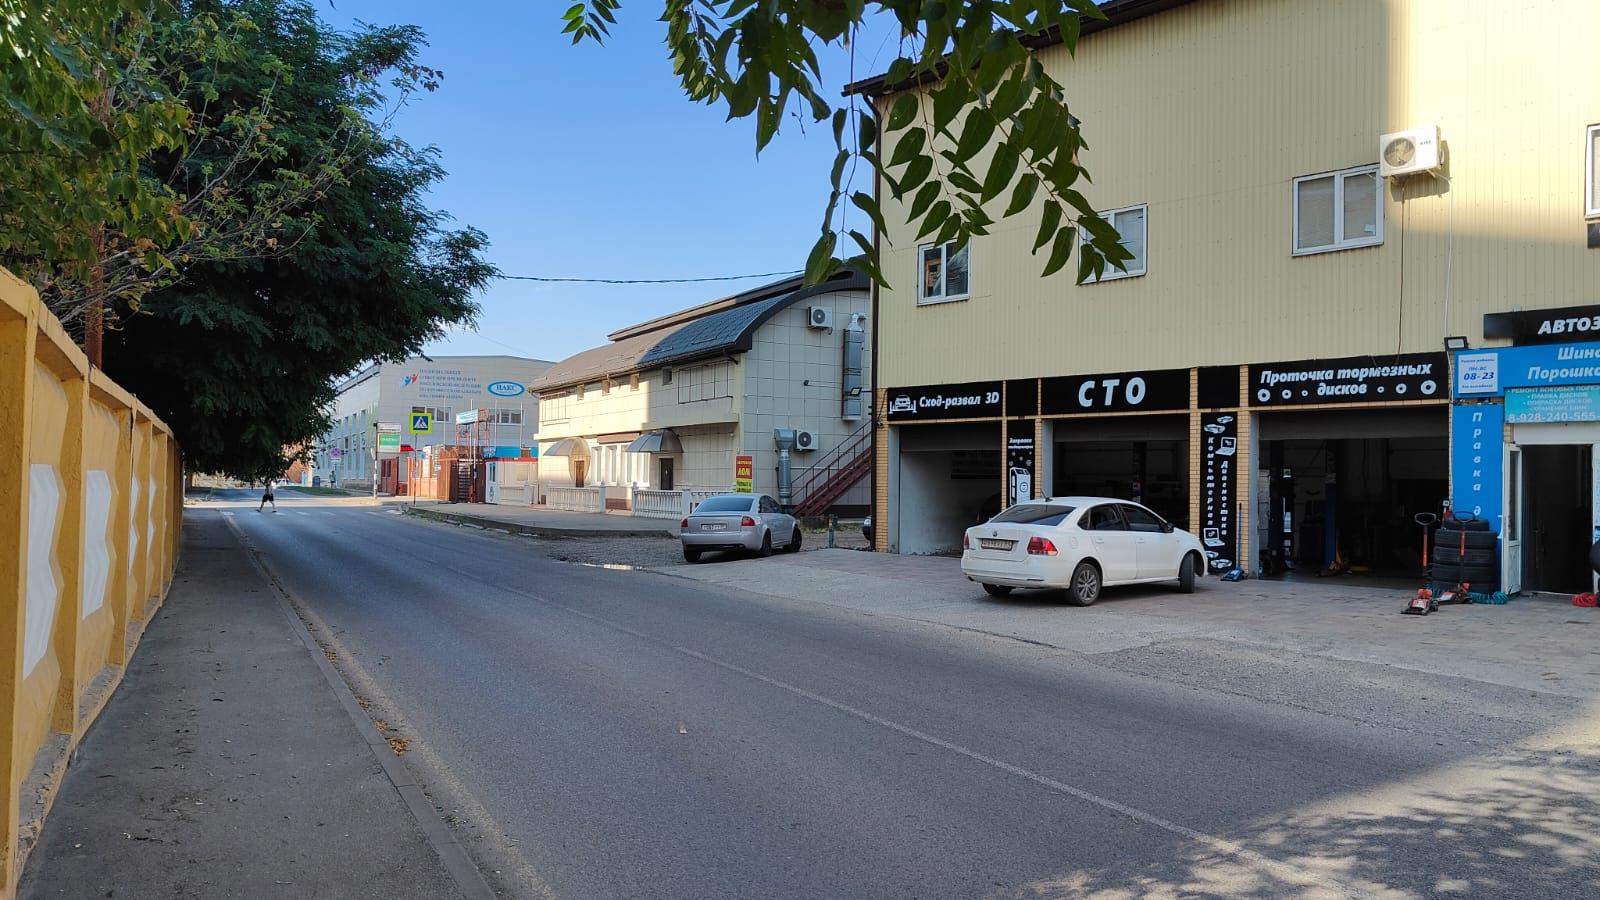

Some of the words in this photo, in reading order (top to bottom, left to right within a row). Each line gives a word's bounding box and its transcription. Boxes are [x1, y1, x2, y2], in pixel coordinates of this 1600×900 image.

[1538, 316, 1600, 335] АВТОЗ
[1260, 369, 1334, 386] Проточка
[1337, 363, 1432, 381] тормозных
[919, 395, 982, 409] Сход-развал
[985, 391, 1000, 404] 3D
[1078, 376, 1146, 407] СТО
[1317, 383, 1368, 396] дисков
[1472, 412, 1482, 491] Правка
[1220, 460, 1229, 535] Диагностика
